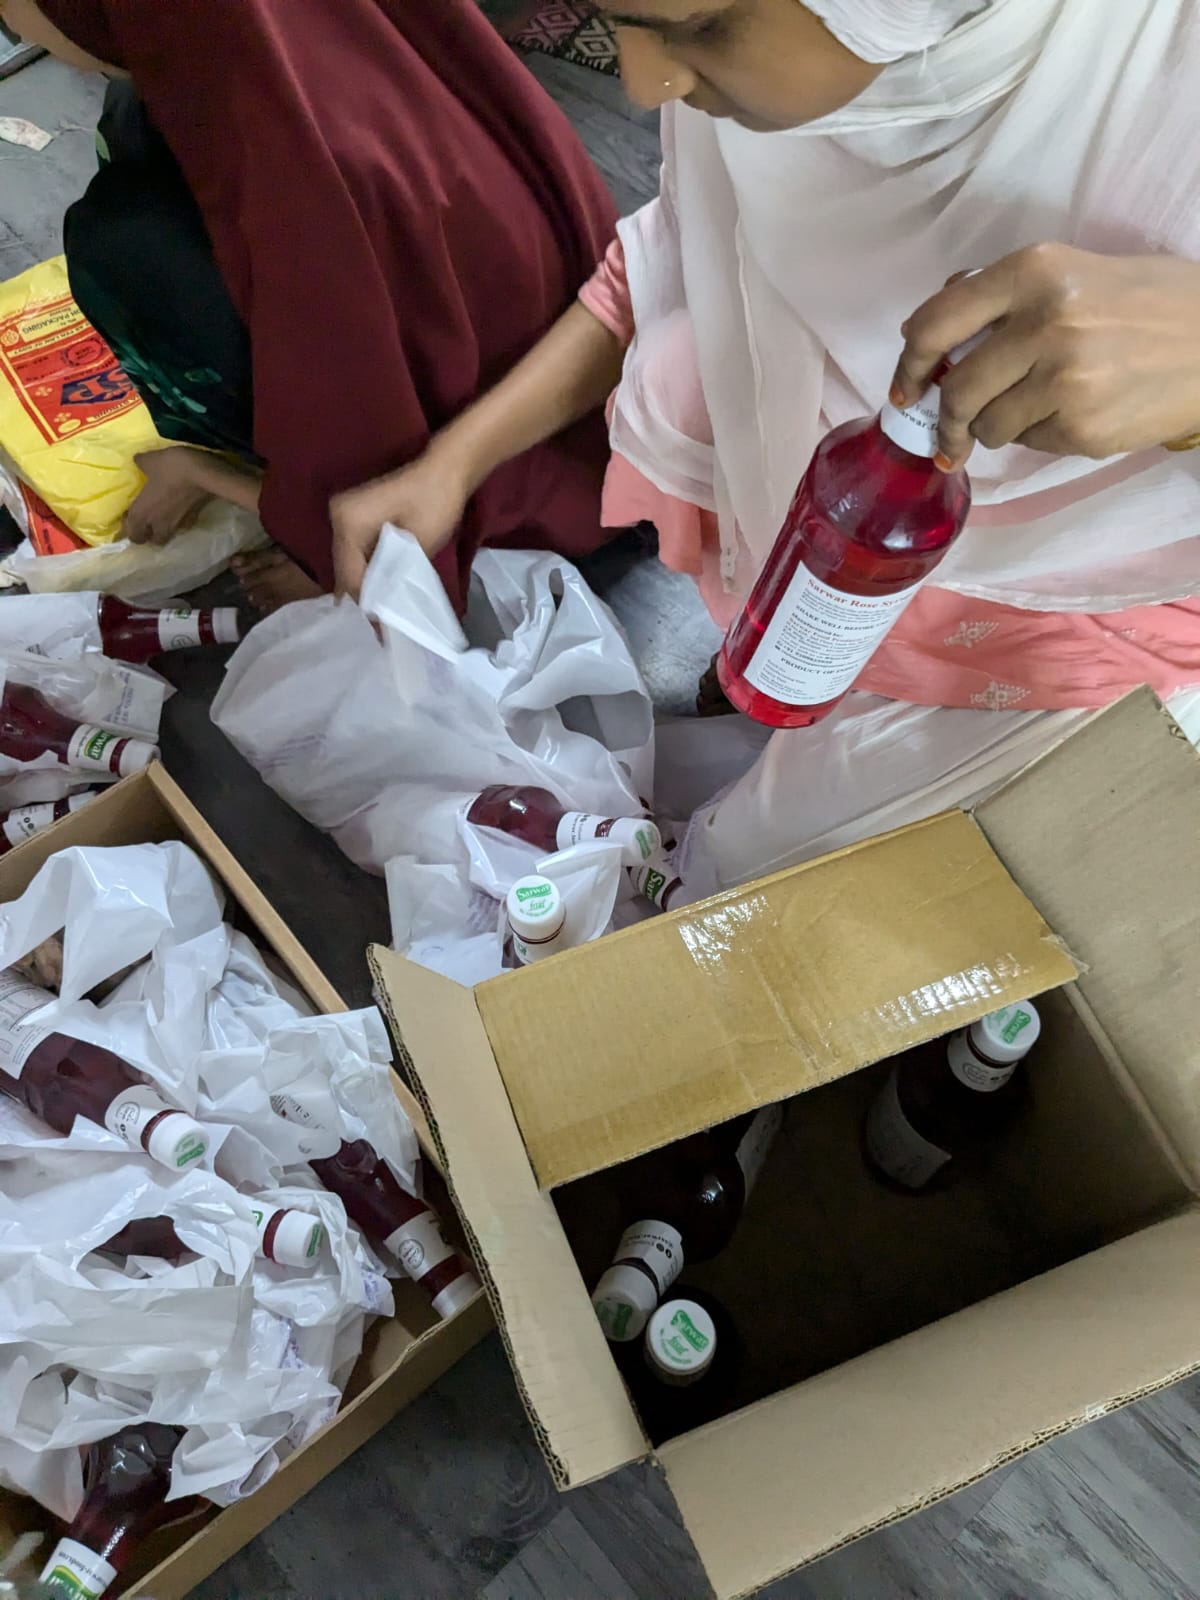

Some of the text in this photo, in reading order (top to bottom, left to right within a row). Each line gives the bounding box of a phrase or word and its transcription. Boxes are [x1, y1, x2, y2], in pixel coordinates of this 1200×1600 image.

[808, 579, 847, 604] Sarwar
[850, 600, 878, 608] Rose
[795, 604, 819, 621] SHAKE
[781, 657, 820, 674] PRODUCT
[518, 884, 551, 900] Sarwar
[671, 1311, 709, 1351] Sarwar
